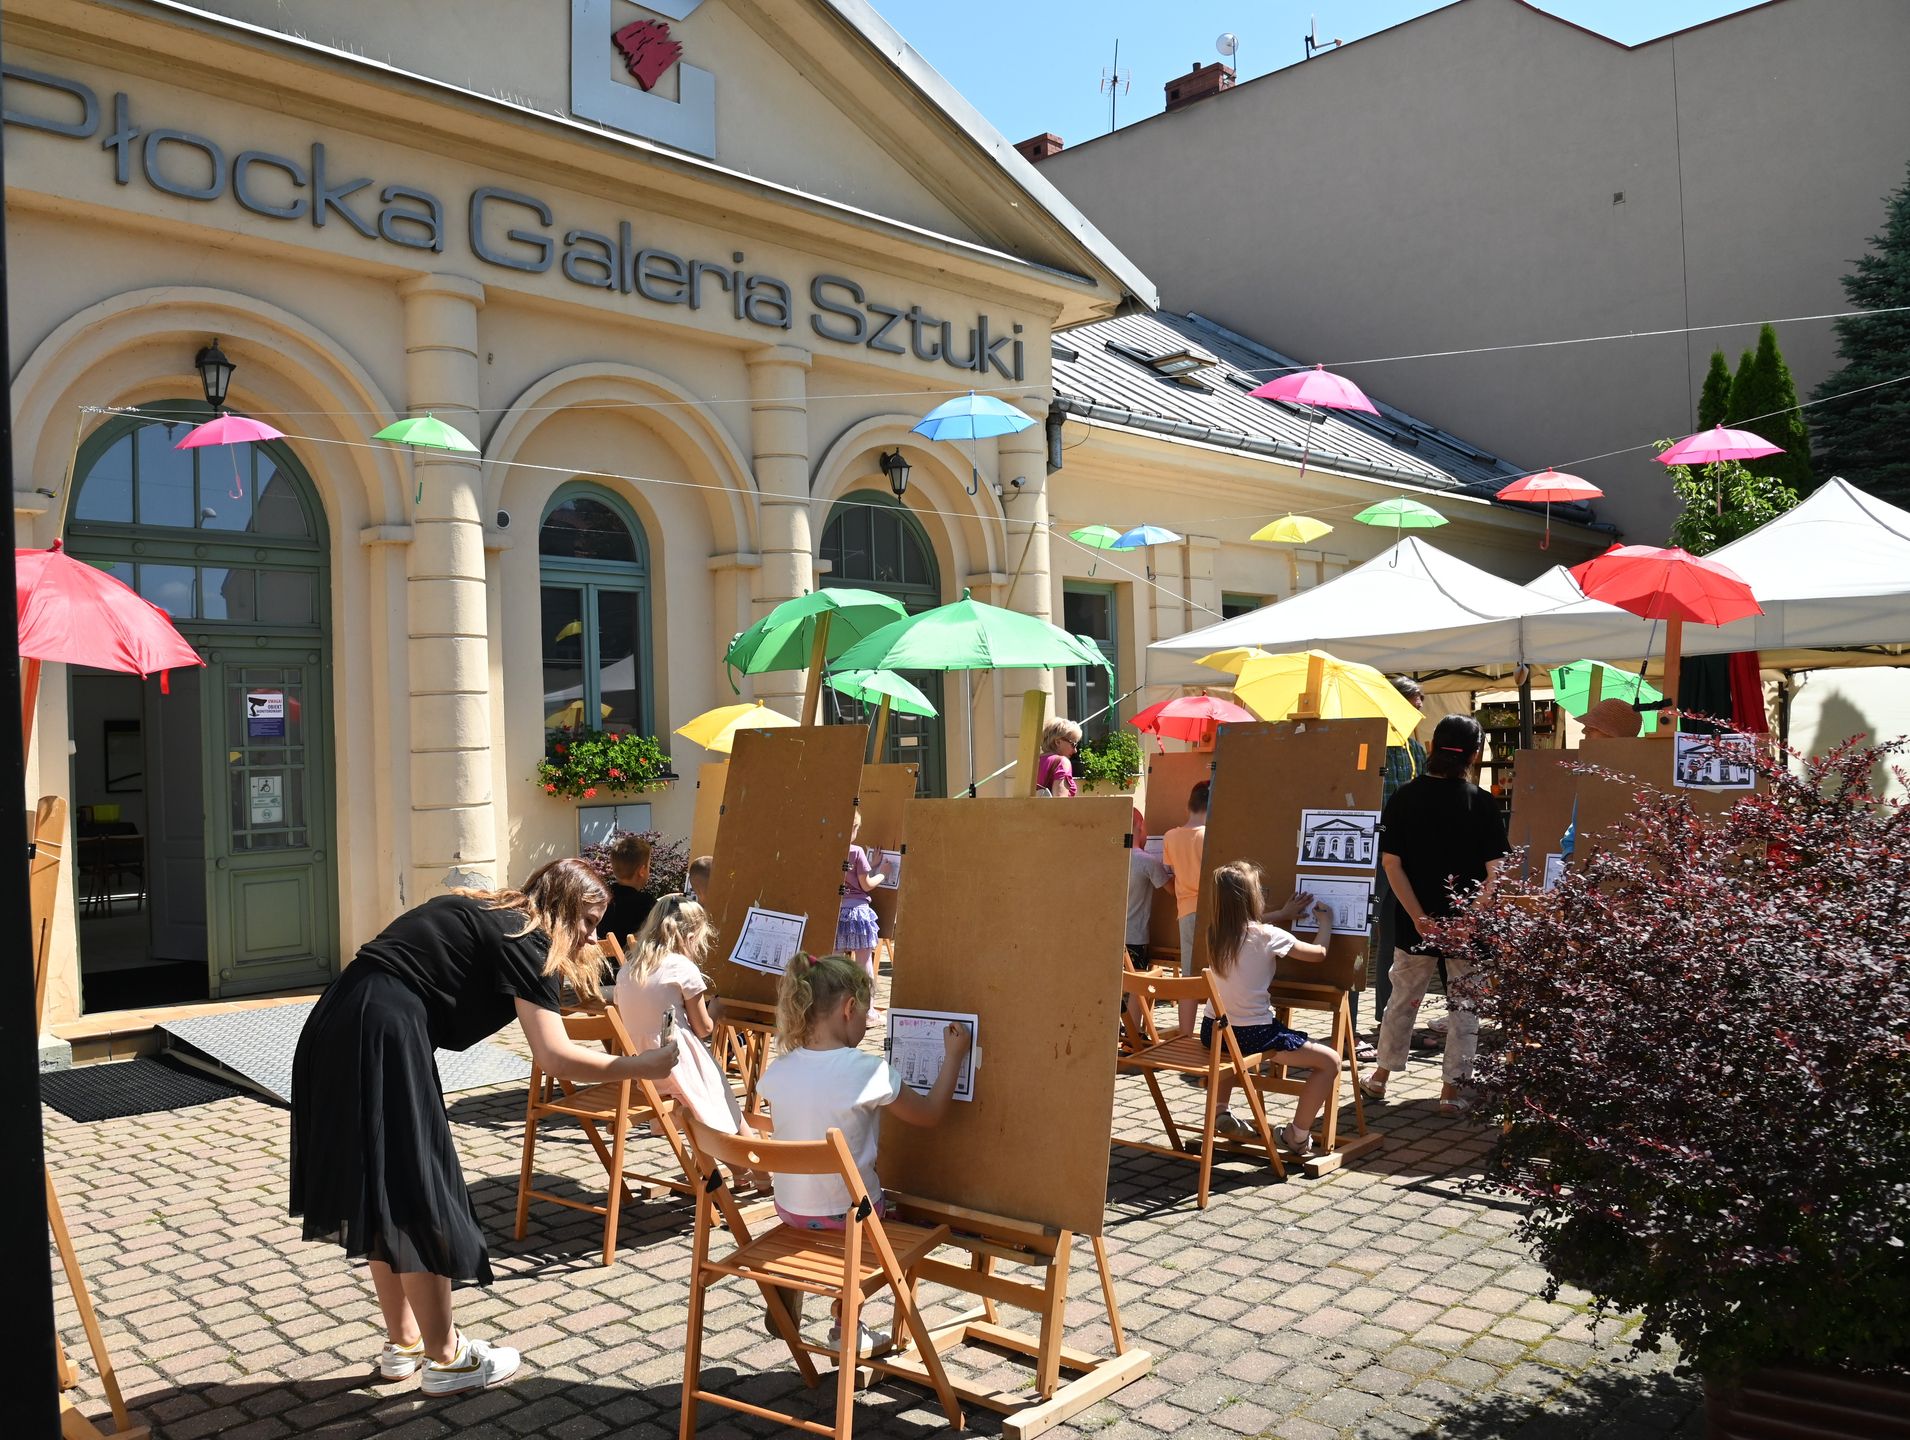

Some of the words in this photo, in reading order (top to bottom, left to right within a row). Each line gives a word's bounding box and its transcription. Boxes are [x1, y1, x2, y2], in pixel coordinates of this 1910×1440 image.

[2, 63, 444, 253] Płocka
[469, 186, 793, 330] Galeria
[811, 273, 1024, 382] Sztuki
